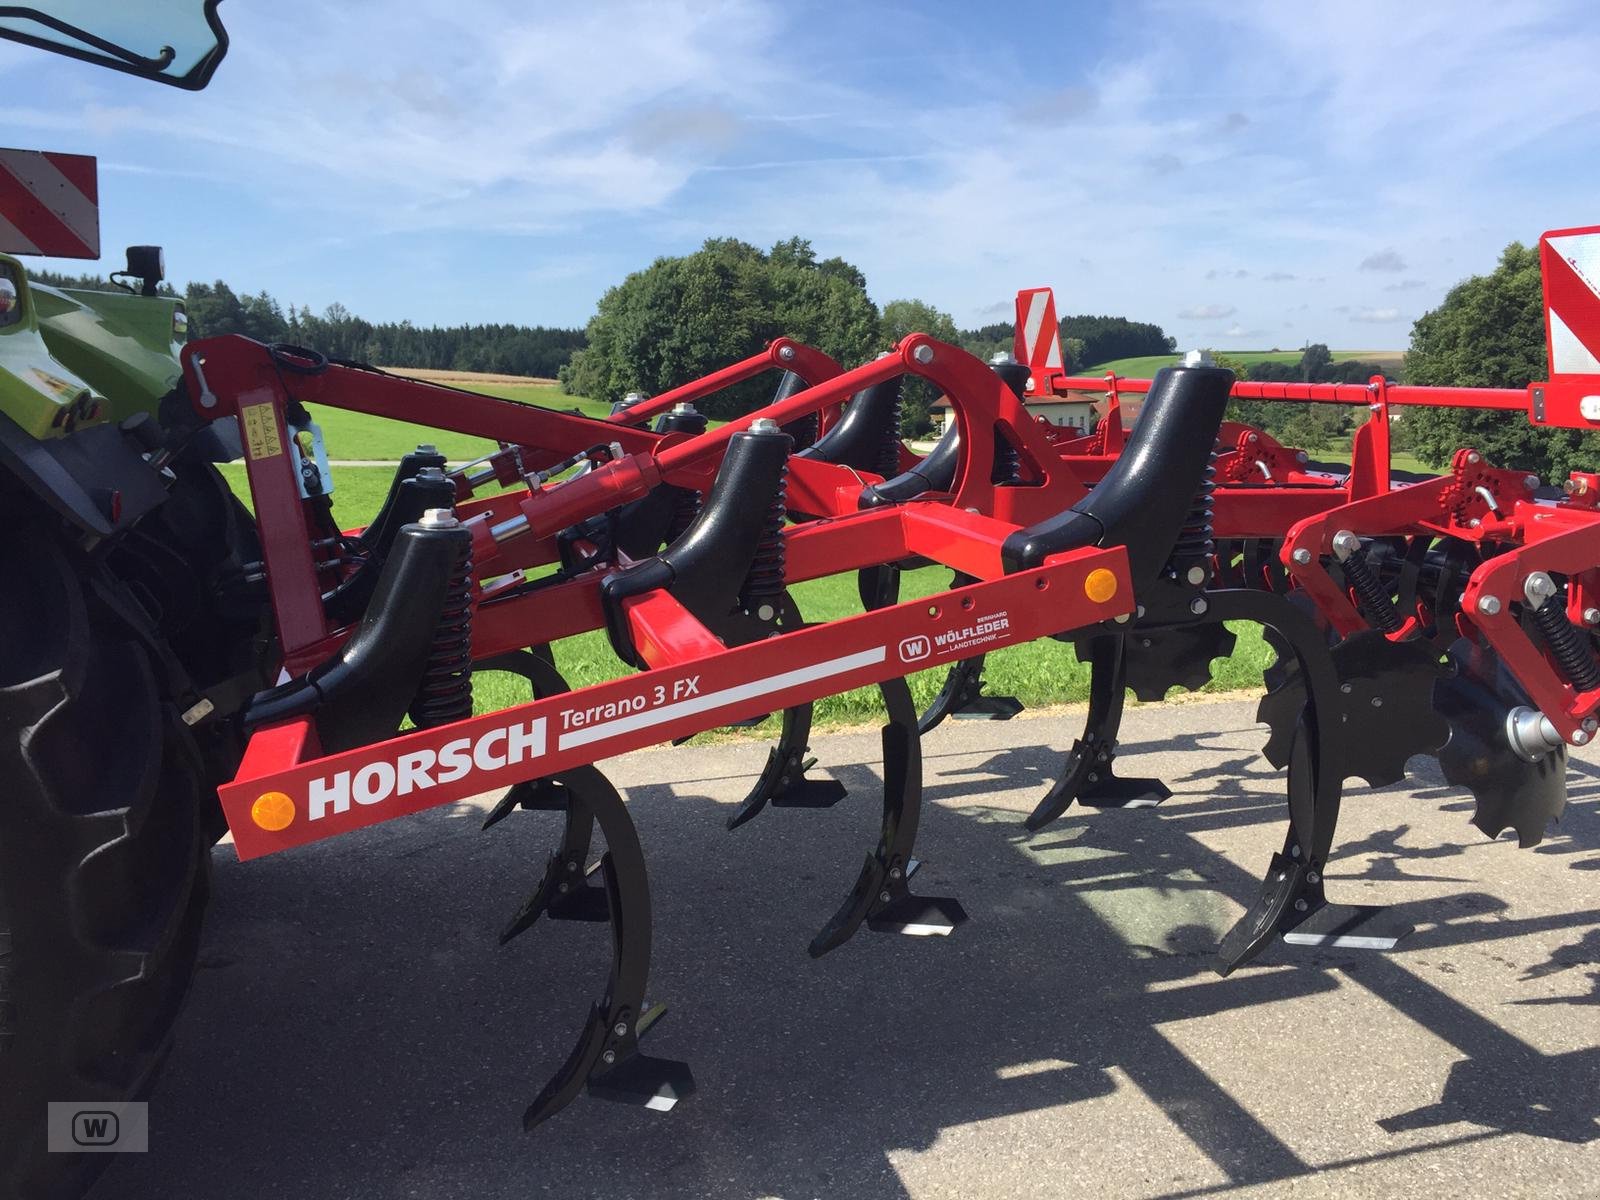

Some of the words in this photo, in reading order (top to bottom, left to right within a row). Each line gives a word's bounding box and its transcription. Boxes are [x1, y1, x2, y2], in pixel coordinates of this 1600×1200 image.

[935, 618, 1010, 646] WÖLFLEDER
[949, 633, 998, 651] LANDTECHNIK
[906, 641, 923, 656] W
[560, 692, 647, 730] Terrano
[653, 684, 667, 707] 3
[674, 675, 701, 700] FX
[308, 717, 547, 821] HORSCH
